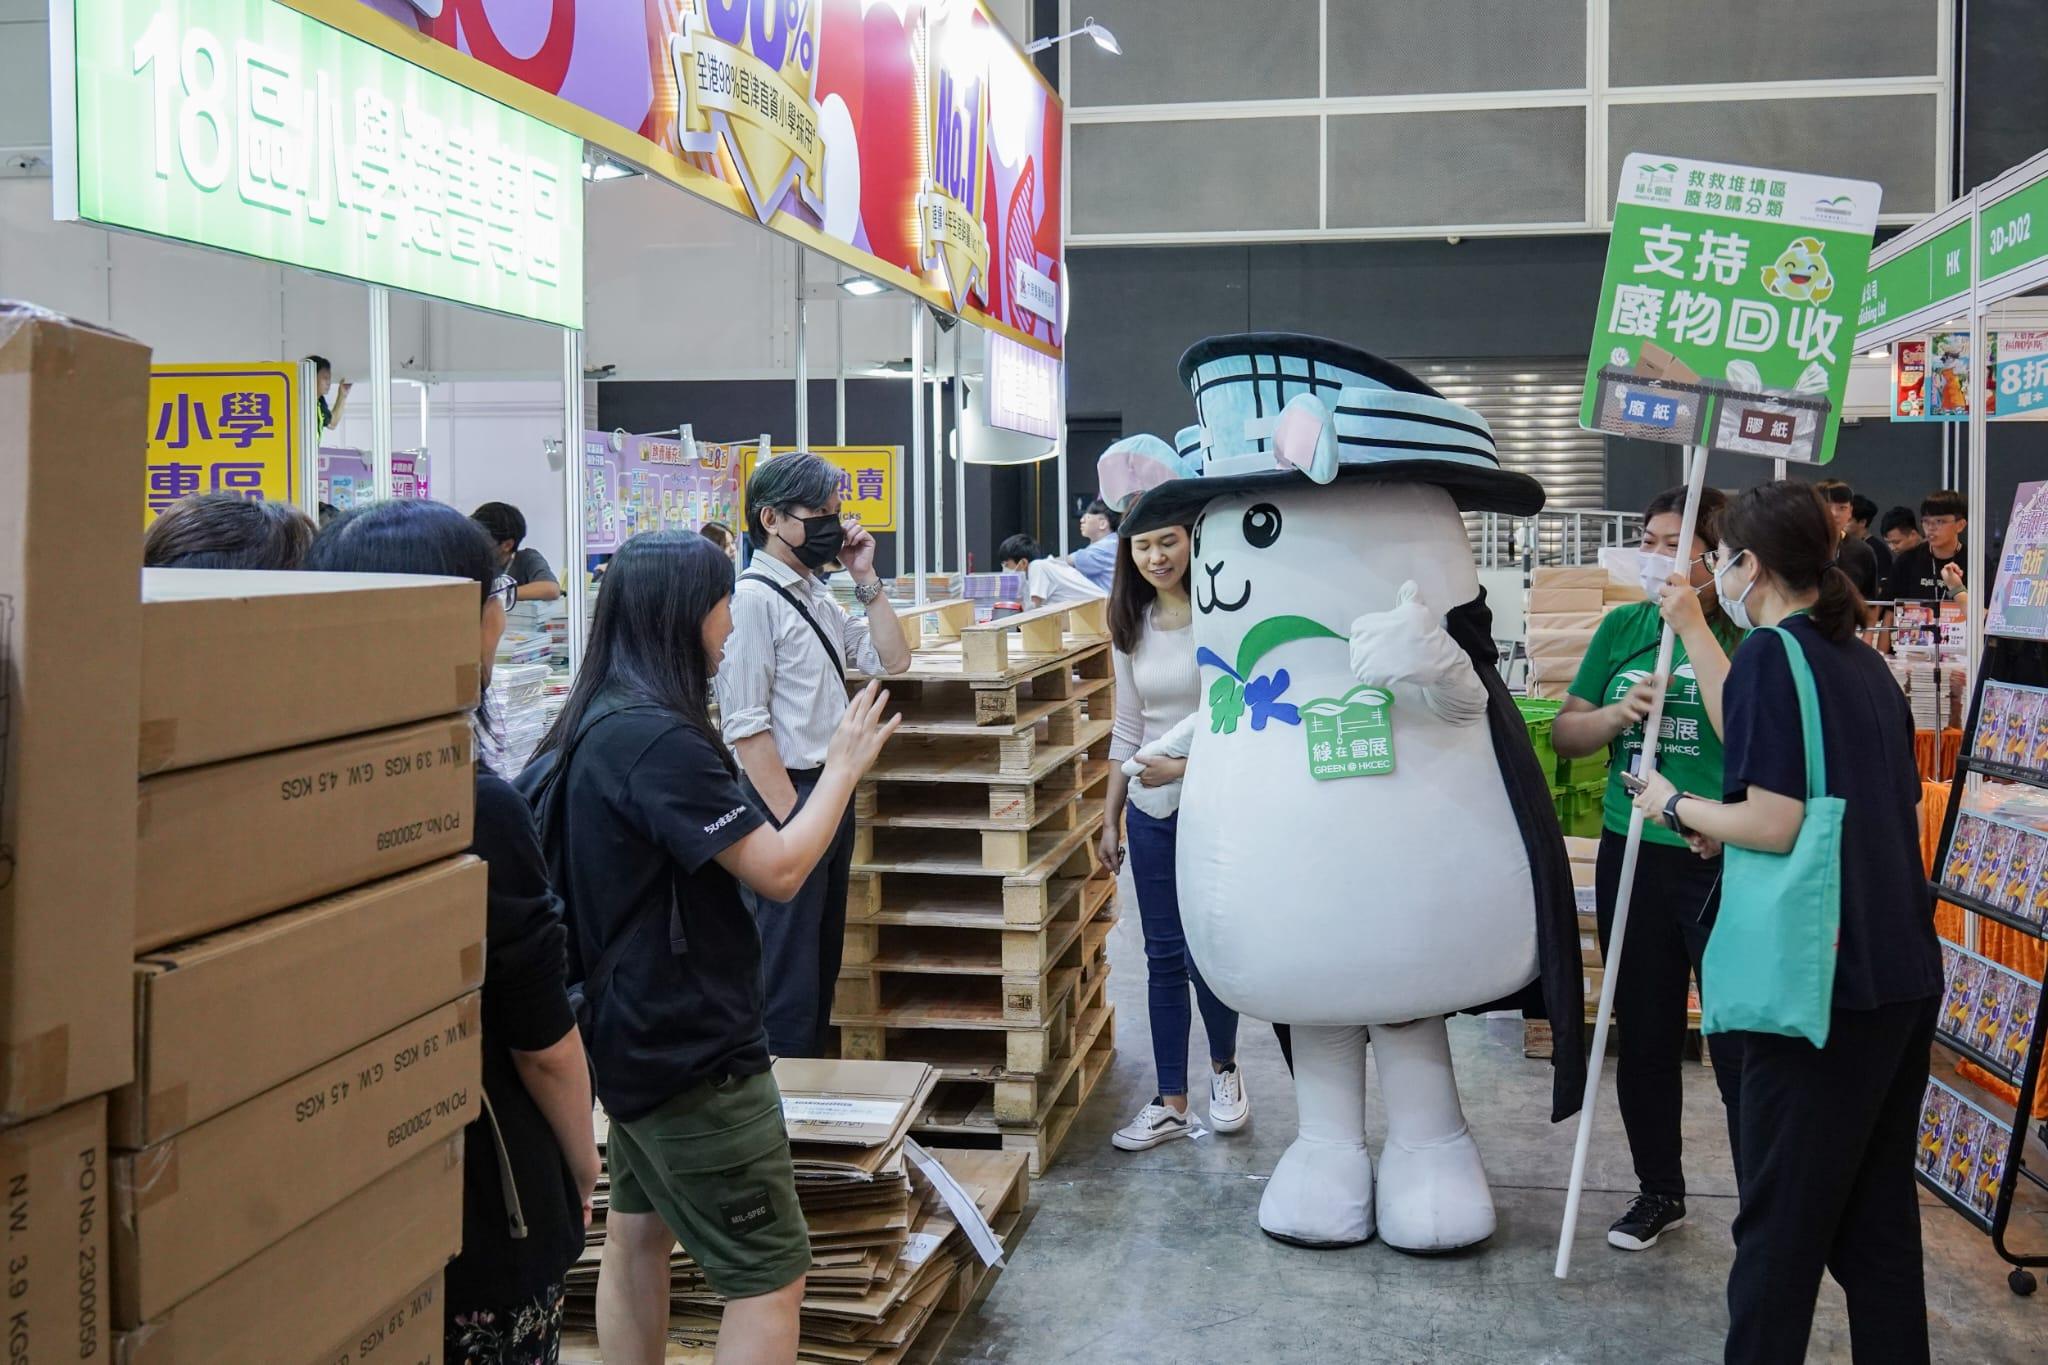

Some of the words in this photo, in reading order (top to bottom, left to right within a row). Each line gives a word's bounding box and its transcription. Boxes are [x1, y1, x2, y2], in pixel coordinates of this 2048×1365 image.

[1688, 169, 1787, 198] 救救堆填區
[1684, 189, 1784, 218] 廢物請分類
[1989, 212, 2031, 256] 3D-D02
[1633, 223, 1750, 287] 支持
[1946, 249, 1961, 277] HK
[1607, 283, 1843, 364] 廢物回收
[154, 392, 274, 449] 小學
[1628, 399, 1671, 421] 廢紙
[1312, 737, 1389, 762] 綠在會展
[1664, 743, 1700, 756] HKCEC
[347, 762, 375, 785] G.W.
[385, 756, 411, 777] KGS
[1314, 764, 1346, 774] GREEN
[1358, 760, 1391, 770] HKCEC
[281, 776, 312, 801] KGS
[319, 772, 338, 792] 4.5
[377, 823, 422, 851] 2300059
[394, 1044, 419, 1072] KGS
[357, 1063, 384, 1091] G.W.
[295, 1091, 325, 1122] KGS
[331, 1081, 349, 1104] 4.5
[387, 1107, 432, 1148] 2300059
[79, 1147, 96, 1191] PO
[79, 1196, 96, 1243] No.
[731, 1206, 766, 1224] MIL-SPEC
[9, 1255, 29, 1300] 3.9
[79, 1246, 97, 1361] 2300059
[10, 1309, 29, 1365] KGS
[360, 1327, 384, 1358] KGS
